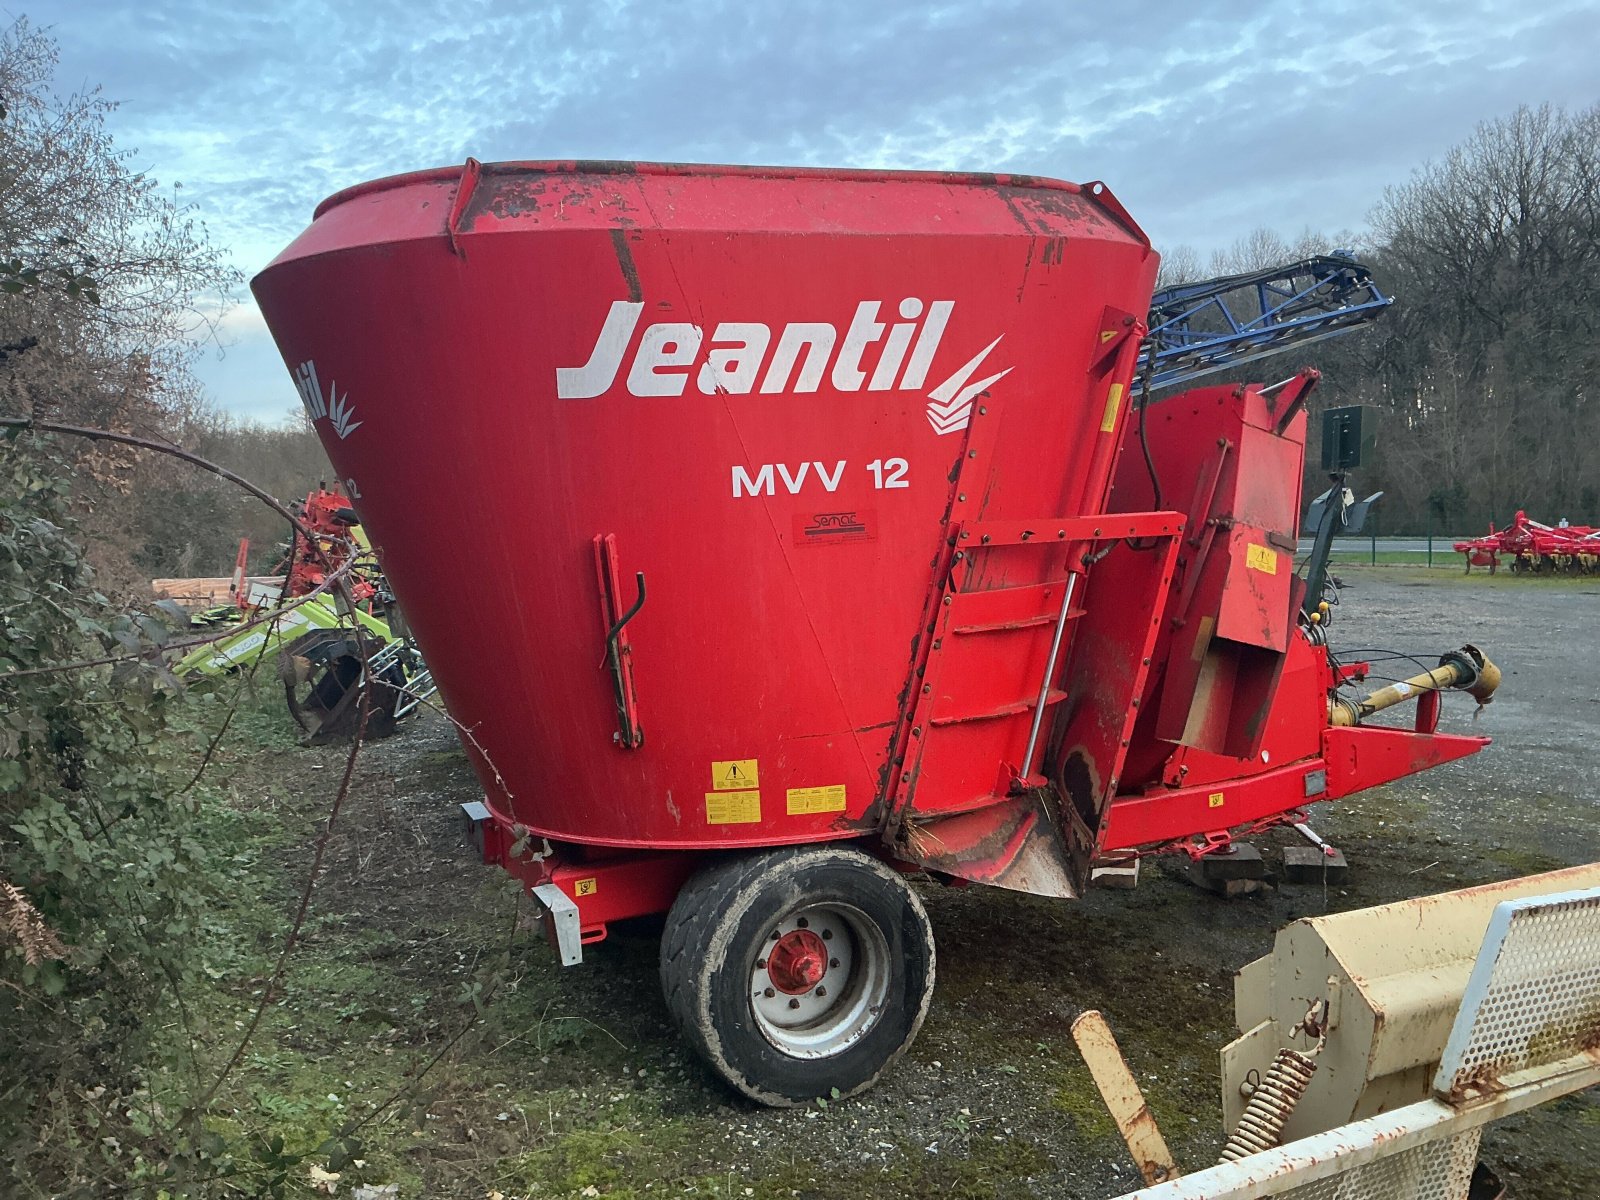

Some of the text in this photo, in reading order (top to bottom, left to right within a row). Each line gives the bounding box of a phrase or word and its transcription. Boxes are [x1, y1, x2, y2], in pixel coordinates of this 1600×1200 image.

[555, 297, 956, 399] Jeantil
[731, 458, 910, 498] MVV 12
